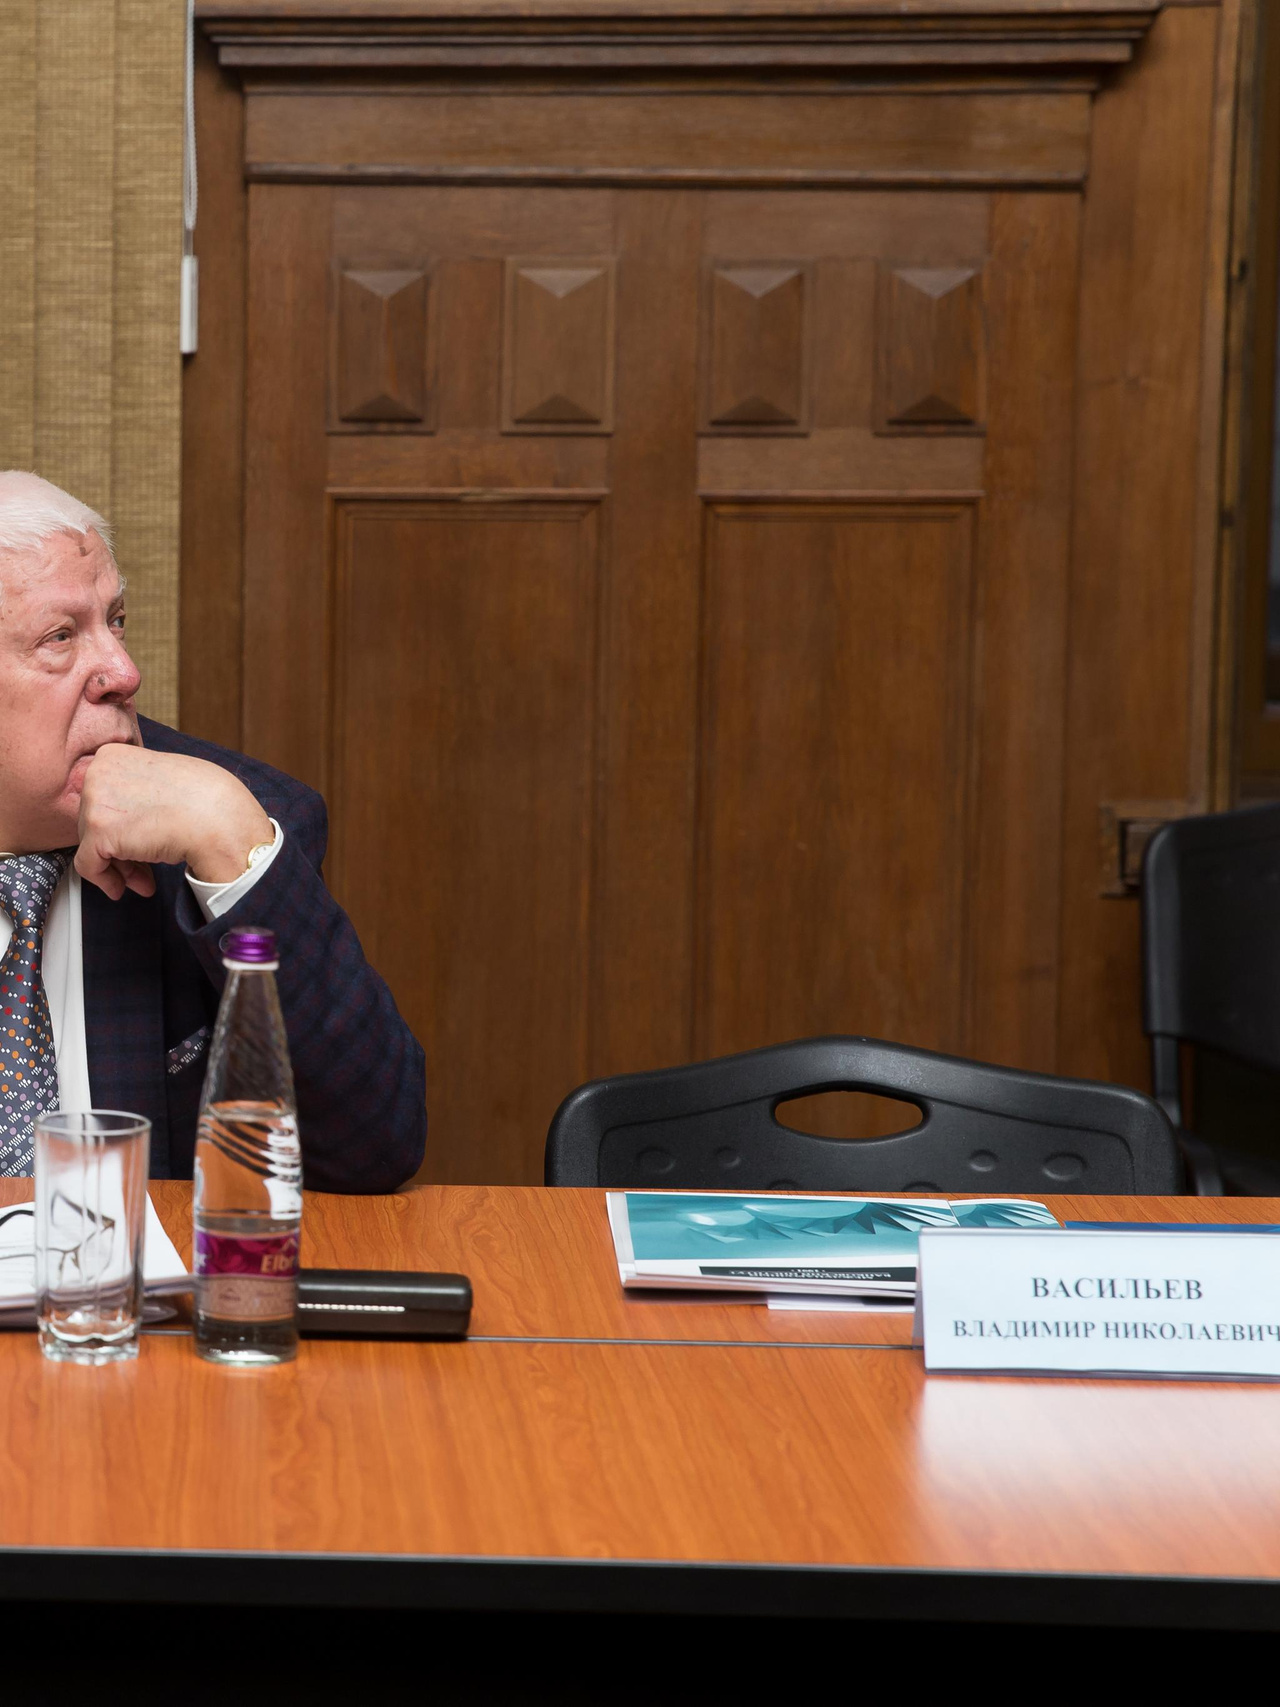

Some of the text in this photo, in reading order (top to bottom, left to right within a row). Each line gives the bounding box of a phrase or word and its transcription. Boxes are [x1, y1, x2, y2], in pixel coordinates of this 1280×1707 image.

[1031, 1277, 1203, 1300] ВАСИЛЬЕВ
[953, 1320, 1280, 1342] ВЛАДИМИР НИКОЛАЕВИЧ
